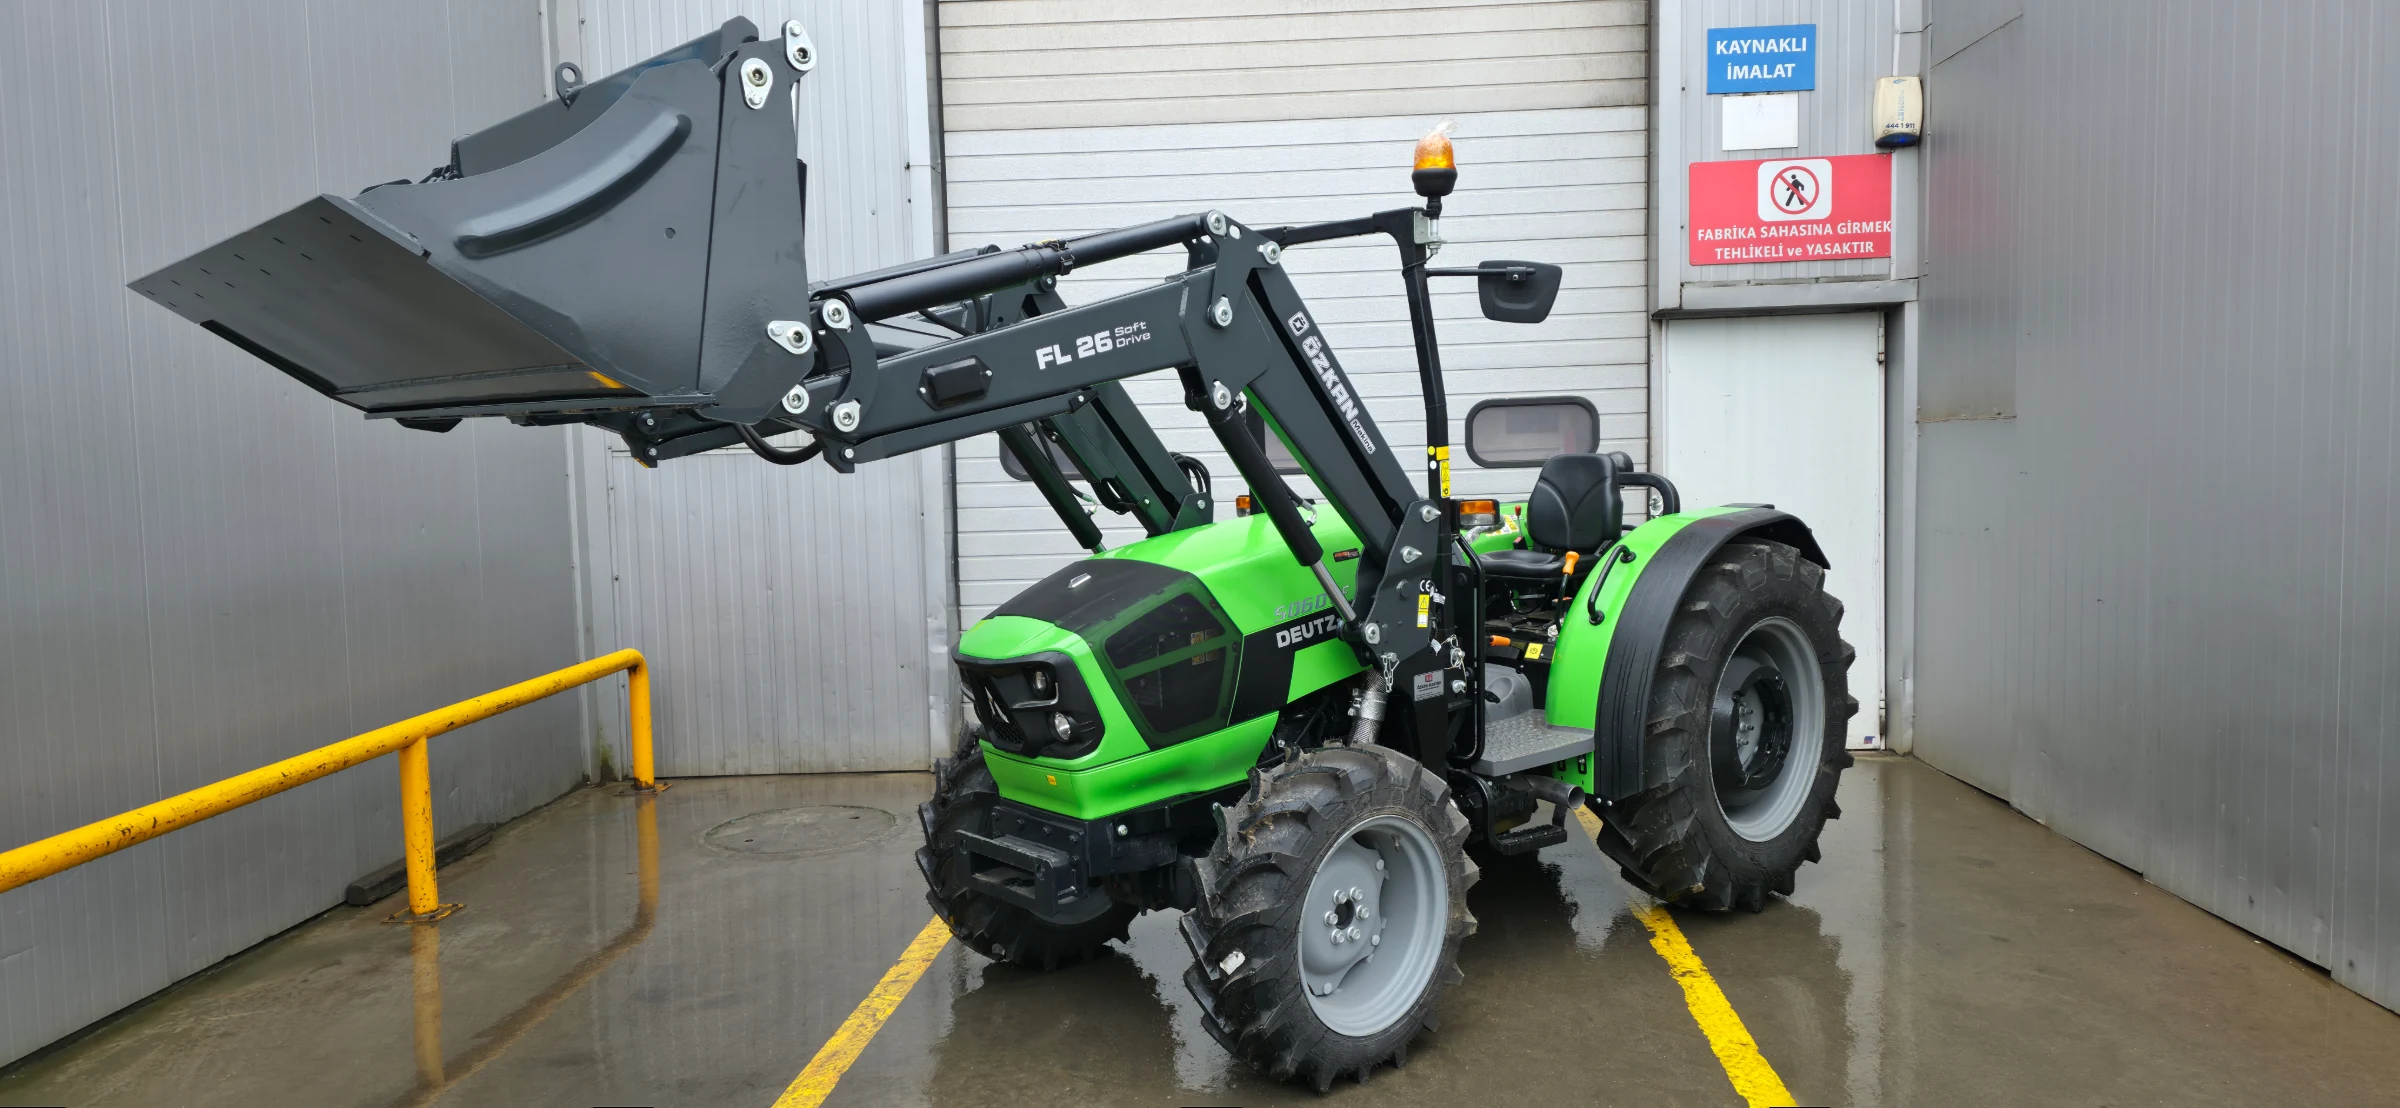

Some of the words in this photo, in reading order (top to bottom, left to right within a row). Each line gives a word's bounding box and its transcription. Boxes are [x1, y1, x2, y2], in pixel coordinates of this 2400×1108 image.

[1716, 37, 1807, 55] KAYNAKLI
[1727, 62, 1796, 80] İMALAT
[1697, 225, 1757, 241] FABRİKA
[1760, 223, 1833, 239] SAHASINA
[1837, 219, 1892, 235] GİRMEK
[1715, 242, 1784, 260] TEHLİKELİ
[1787, 247, 1803, 256] ve
[1806, 241, 1875, 256] YASAKTIR
[1115, 321, 1147, 337] Soft
[1116, 332, 1151, 348] Drive
[1035, 344, 1073, 370] FL
[1076, 330, 1114, 359] 26
[1302, 335, 1359, 422] ÖZKAN
